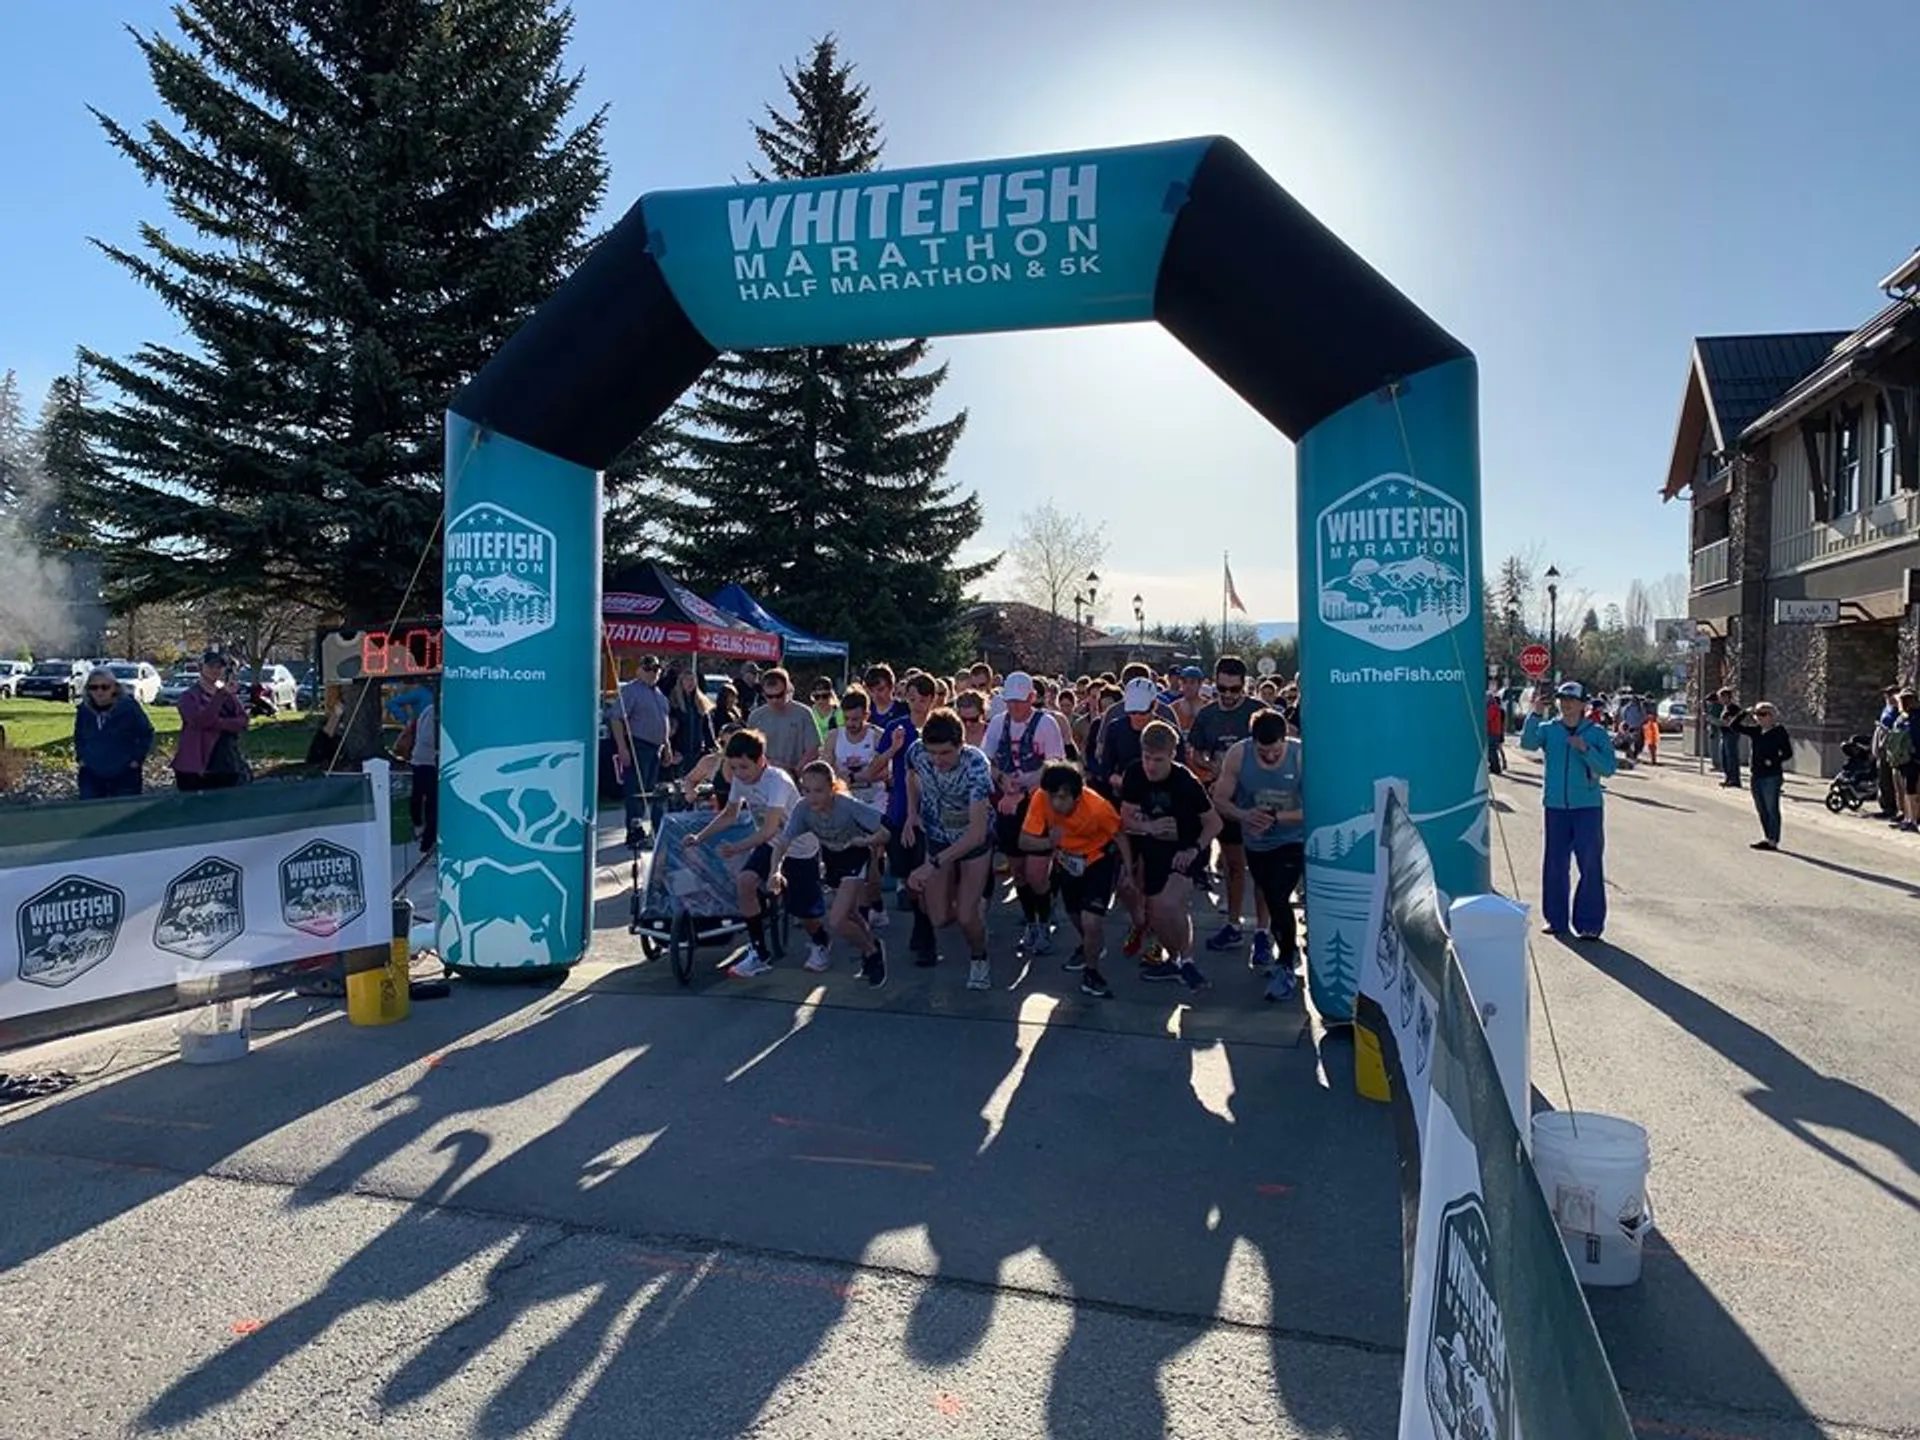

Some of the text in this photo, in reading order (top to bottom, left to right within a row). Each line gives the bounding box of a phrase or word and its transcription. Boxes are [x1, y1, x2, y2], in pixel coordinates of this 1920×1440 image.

[728, 164, 1098, 251] WHITEFISH
[734, 225, 1098, 280] MARATHON
[739, 255, 1101, 301] HALF MARATHON & 5K
[1326, 507, 1458, 544] WHITEFISH
[448, 532, 543, 560] WHITEFISH
[1330, 541, 1459, 559] MARATHON
[606, 623, 666, 643] TATION
[1368, 623, 1424, 634] MONTANA
[1523, 655, 1548, 666] STOP
[1330, 667, 1465, 684] RunTheFish.com
[288, 856, 352, 880] WHITEFISH
[29, 894, 114, 926] WHITEFISH
[32, 916, 113, 936] MARATHON
